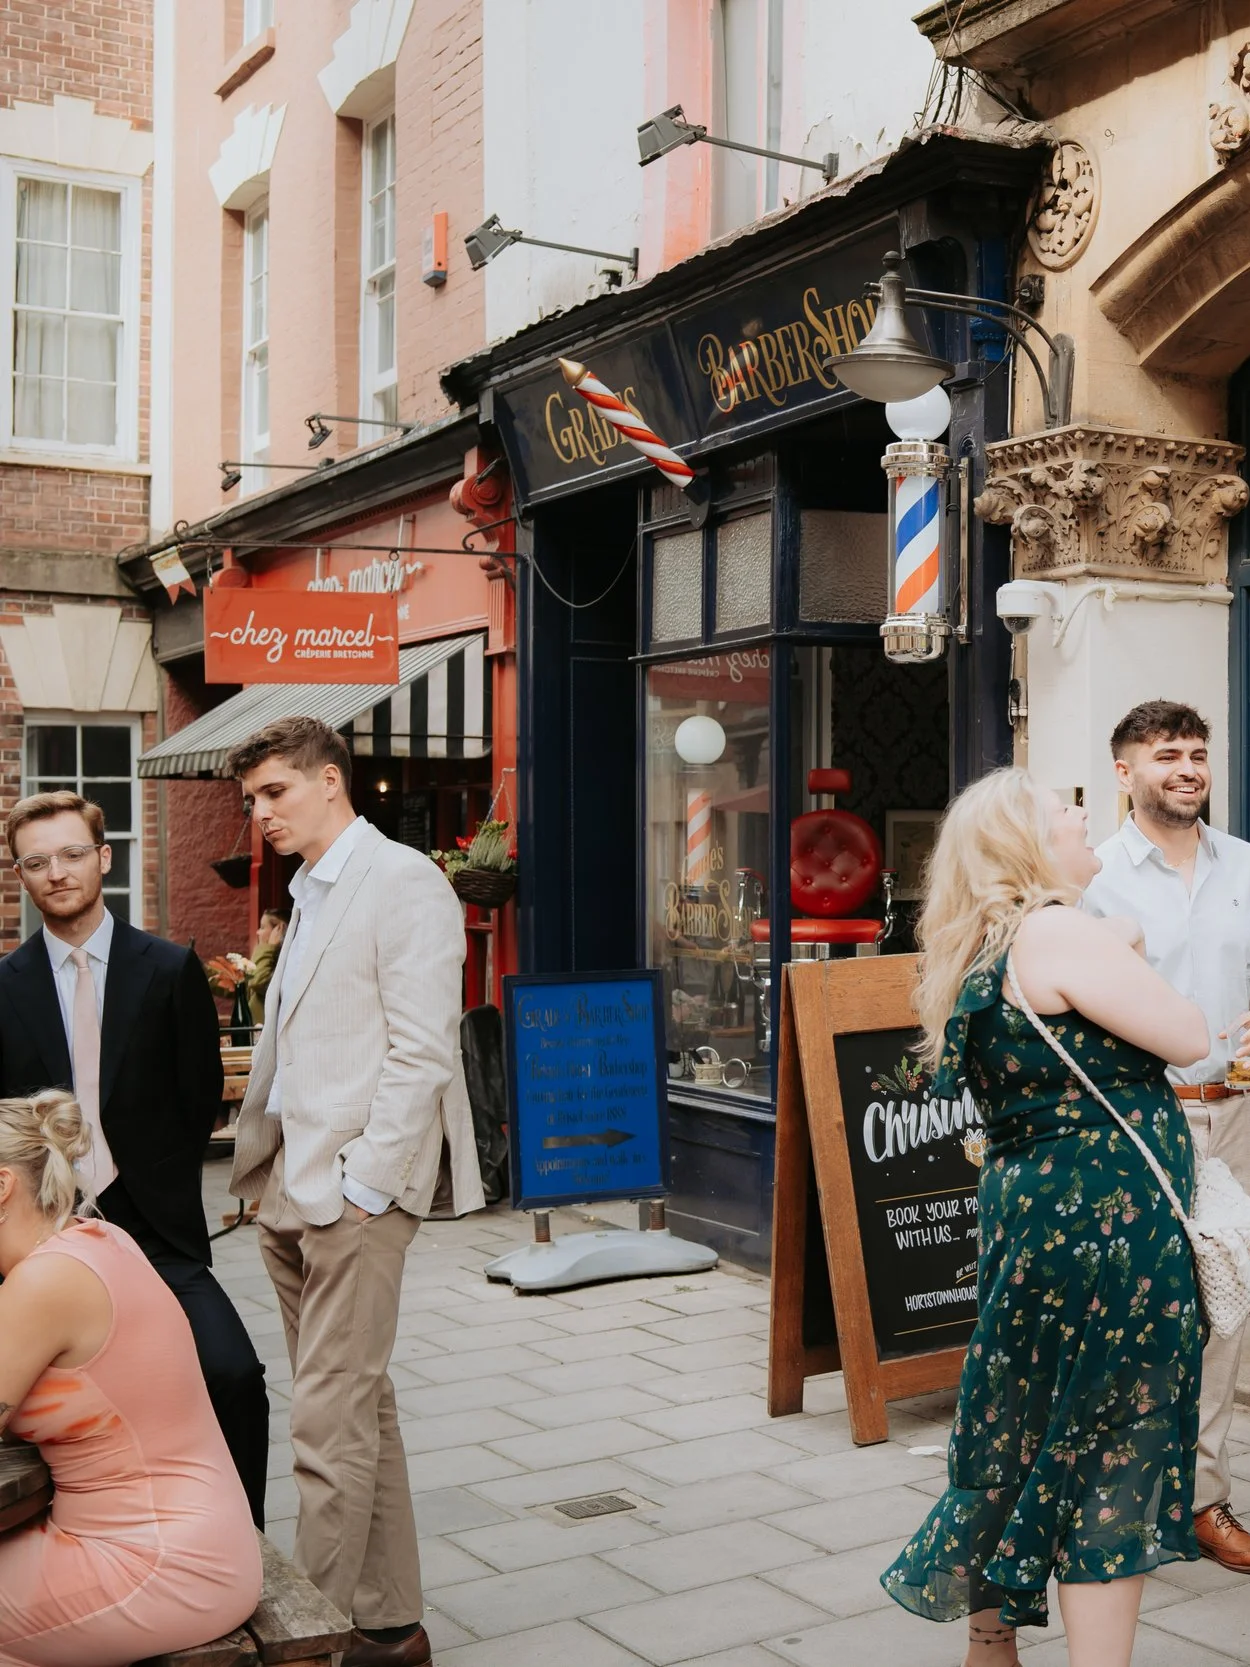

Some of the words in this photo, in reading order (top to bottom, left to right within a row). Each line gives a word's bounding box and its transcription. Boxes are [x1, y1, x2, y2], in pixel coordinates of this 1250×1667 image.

[545, 386, 644, 466] GRADS
[697, 287, 877, 415] BARBERSHO
[230, 610, 288, 663] chez
[294, 613, 375, 647] marcel
[333, 650, 374, 659] BRETONNE
[863, 1078, 984, 1163] Christm
[886, 1205, 922, 1228] BOOK
[925, 1199, 962, 1222] YOUR
[964, 1196, 979, 1215] PA
[895, 1227, 932, 1250] WITH
[904, 1286, 978, 1312] HORTSTOWNHOUS
